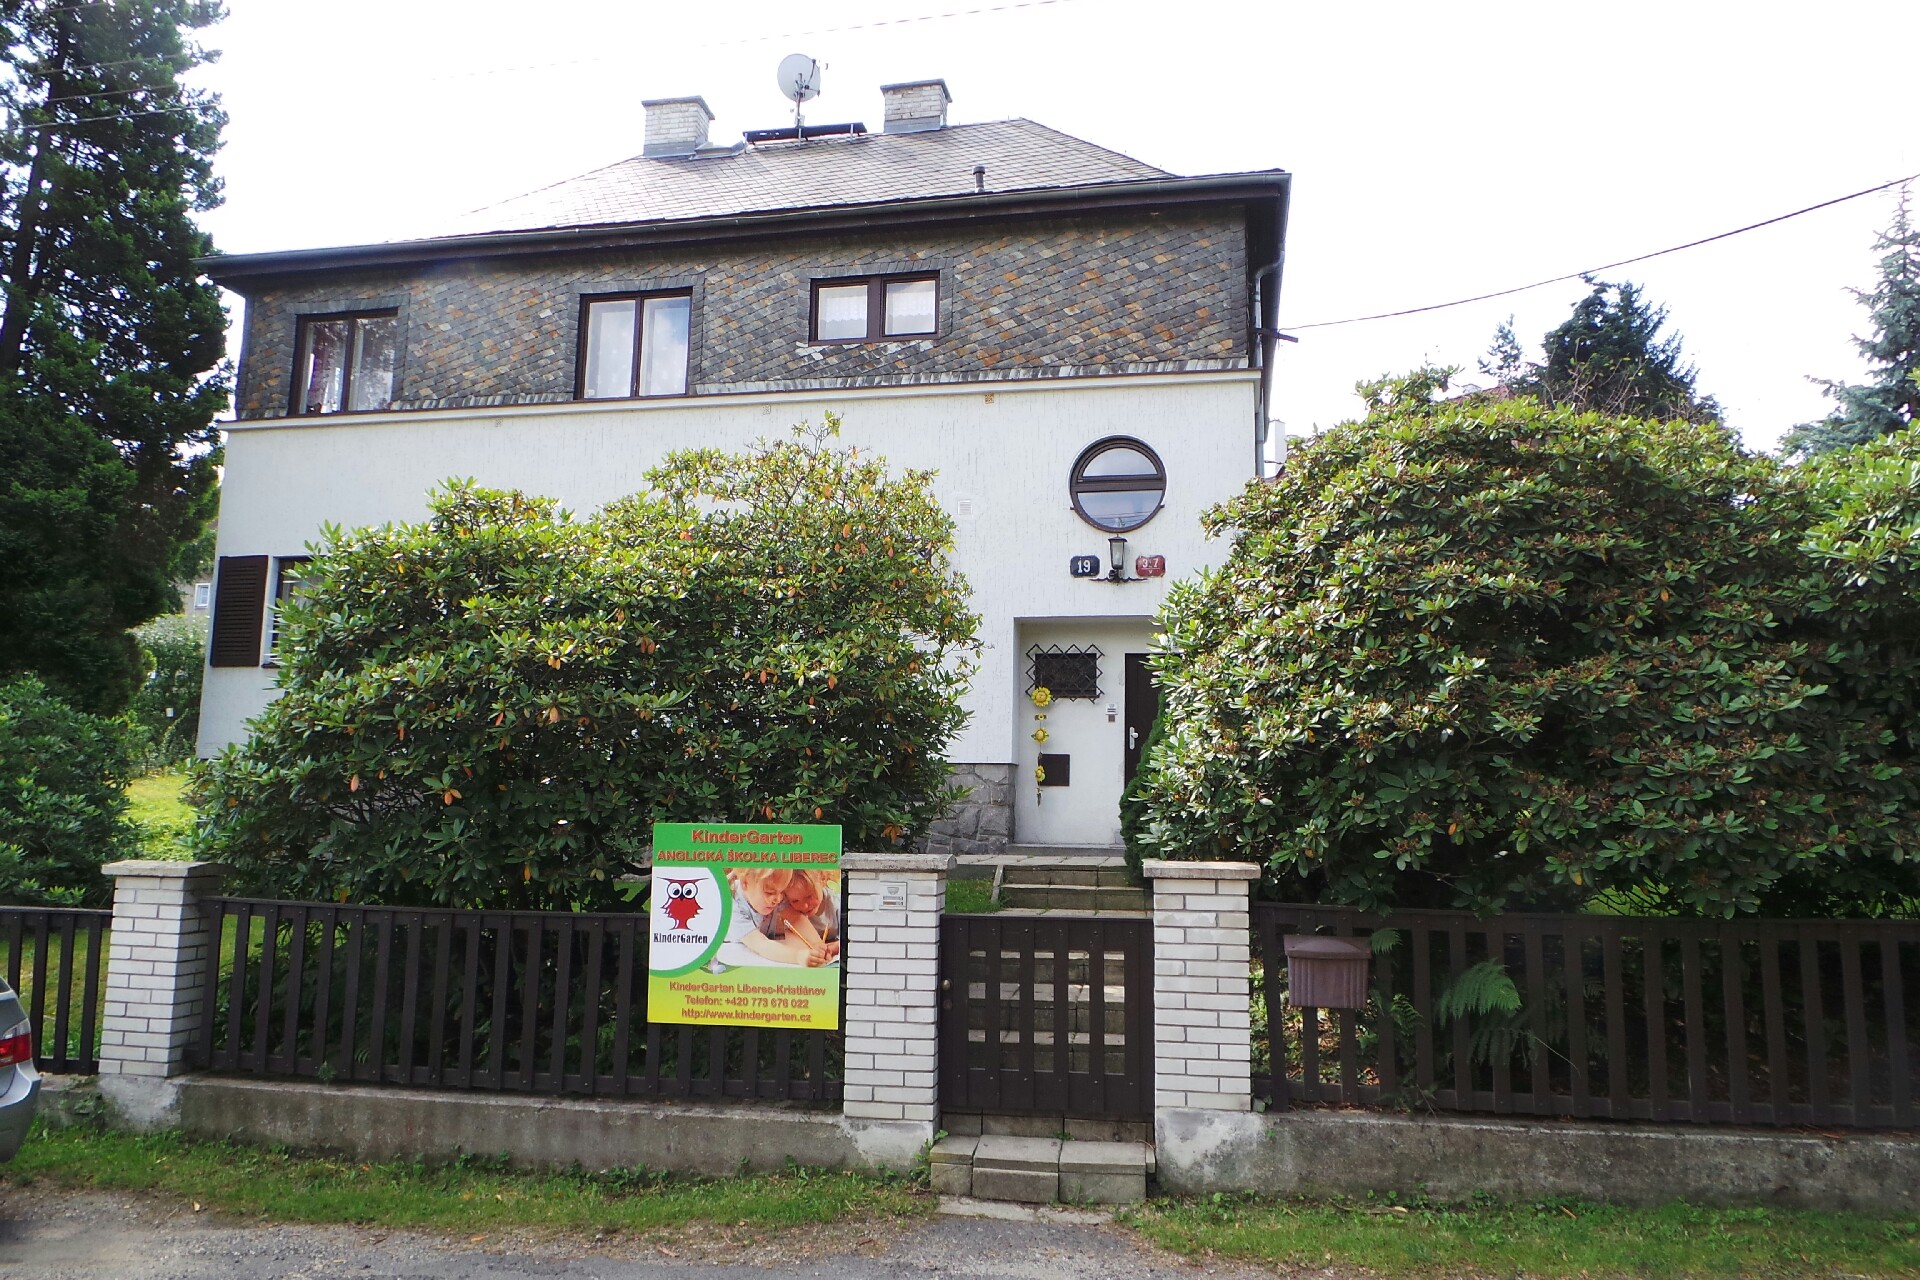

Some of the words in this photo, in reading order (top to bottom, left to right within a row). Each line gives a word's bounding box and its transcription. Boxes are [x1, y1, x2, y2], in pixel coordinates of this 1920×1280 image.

[1077, 559, 1091, 574] 19
[691, 829, 803, 845] KinderGarten
[657, 848, 723, 862] ANGLICKÁ
[727, 848, 776, 863] ŠKOLKA
[781, 851, 838, 864] LIBEREC
[653, 932, 708, 944] KinderGarten
[669, 981, 735, 994] KinderGarten
[685, 994, 722, 1006] Telefon:
[724, 996, 749, 1007] +420
[681, 1007, 812, 1023] http://www.kindergarten.cz
